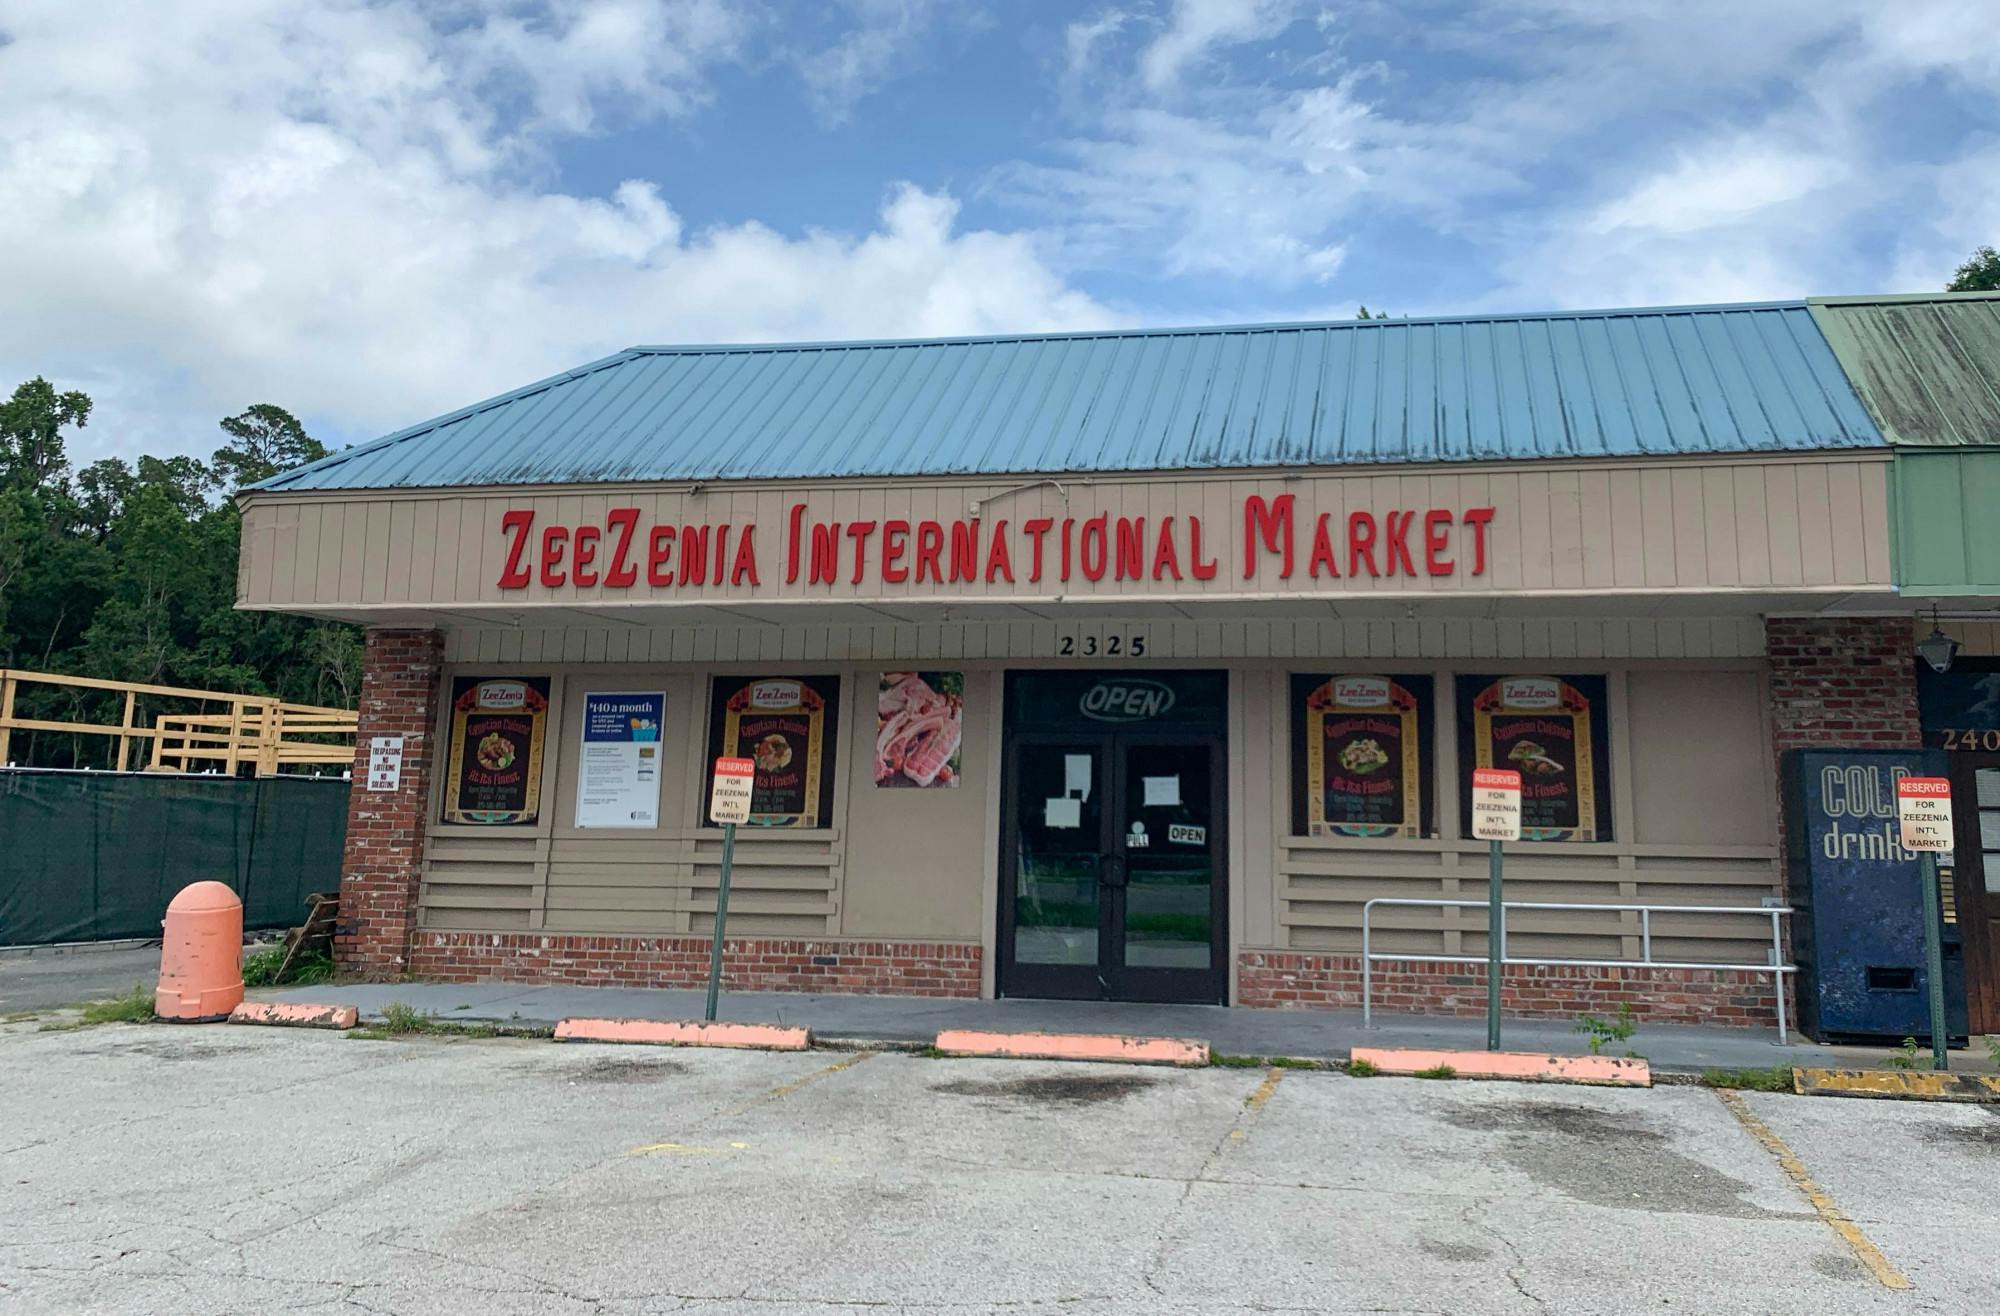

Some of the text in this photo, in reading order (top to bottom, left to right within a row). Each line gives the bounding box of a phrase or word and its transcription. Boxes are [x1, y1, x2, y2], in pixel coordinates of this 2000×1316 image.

[1060, 635, 1145, 656] 2325
[1086, 685, 1165, 717] OPEN
[611, 704, 617, 713] a
[619, 702, 653, 713] month
[717, 761, 753, 772] RESERVED
[1474, 773, 1519, 785] RESERVED
[715, 788, 750, 797] ZEEZENIA
[1900, 782, 1948, 793] RESERVED
[1488, 791, 1505, 800] FOR
[1475, 803, 1517, 813] ZEEZENIA
[715, 811, 744, 820] MARKET
[1904, 813, 1949, 822] ZEEZENIA
[1171, 826, 1203, 841] OPEN
[1479, 828, 1515, 838] MARKET
[1915, 826, 1939, 835] INT'L
[1909, 839, 1948, 848] MARKET
